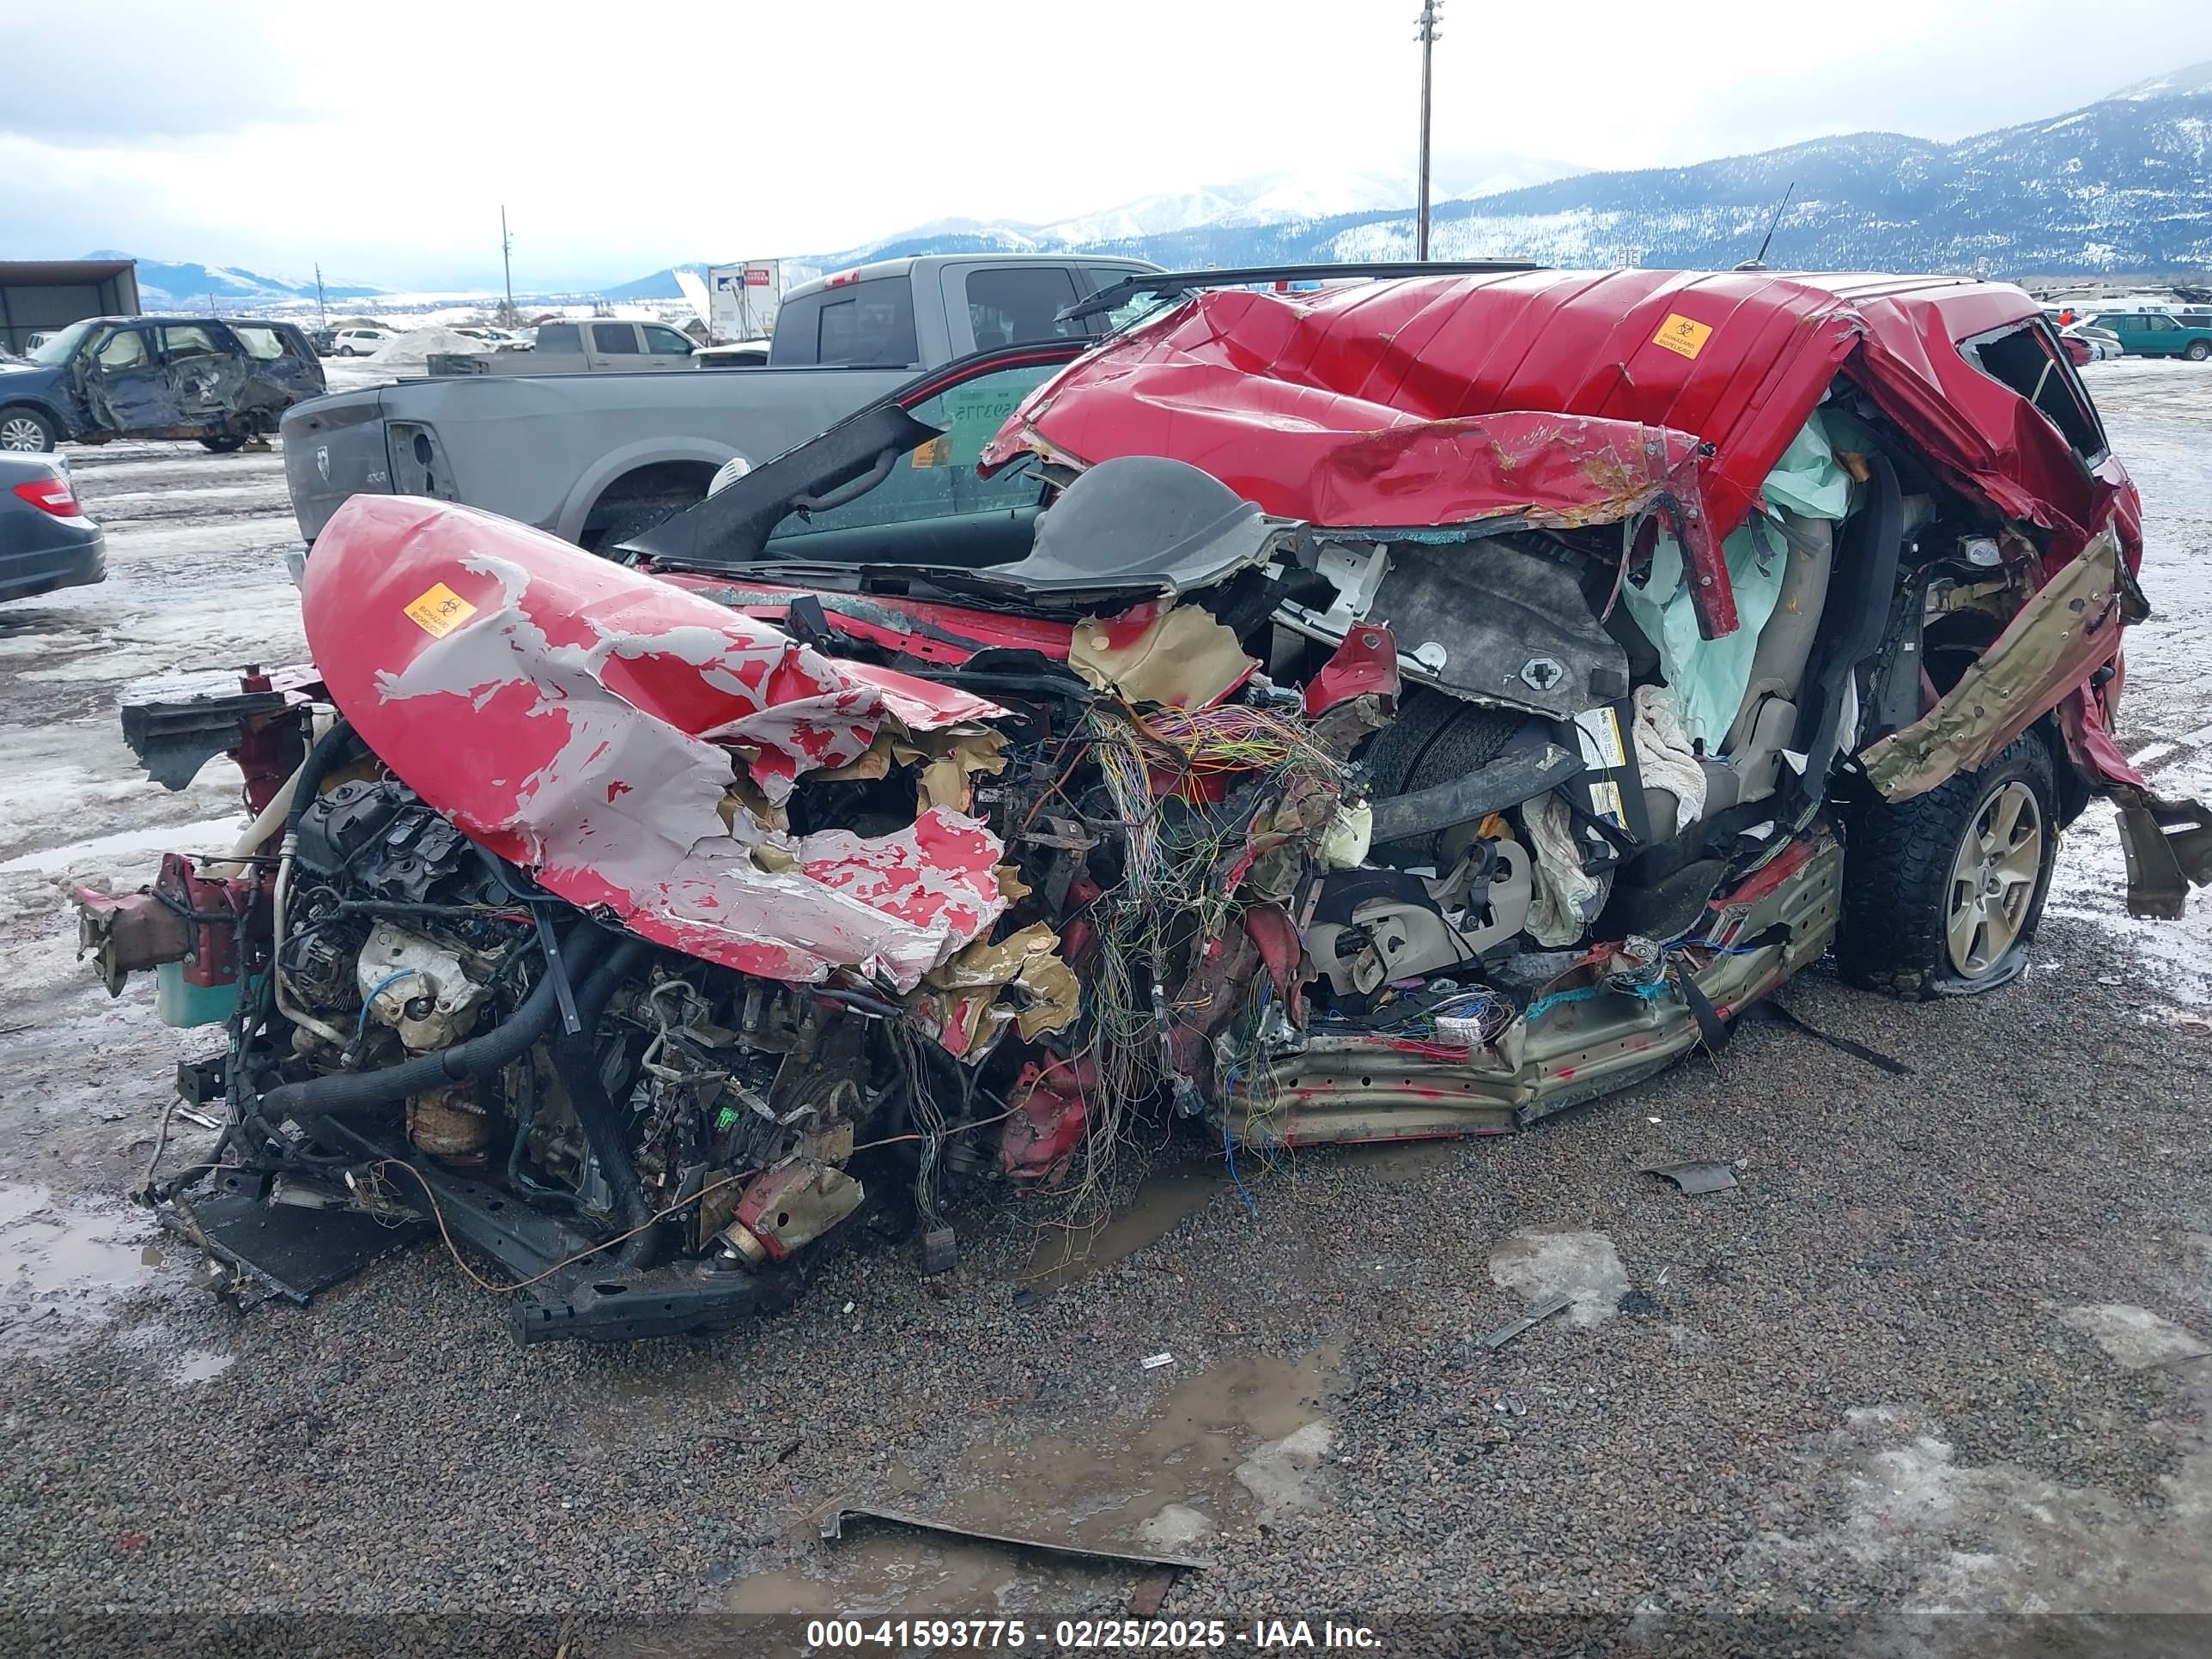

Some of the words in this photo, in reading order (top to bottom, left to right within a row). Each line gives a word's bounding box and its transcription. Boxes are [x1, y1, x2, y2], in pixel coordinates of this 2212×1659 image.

[1658, 338, 1692, 356] BIOPELIGRO
[1662, 332, 1695, 349] BIOHAZARD
[410, 611, 441, 635] BIOPELIGRO
[418, 605, 449, 628] BIOHAZARD
